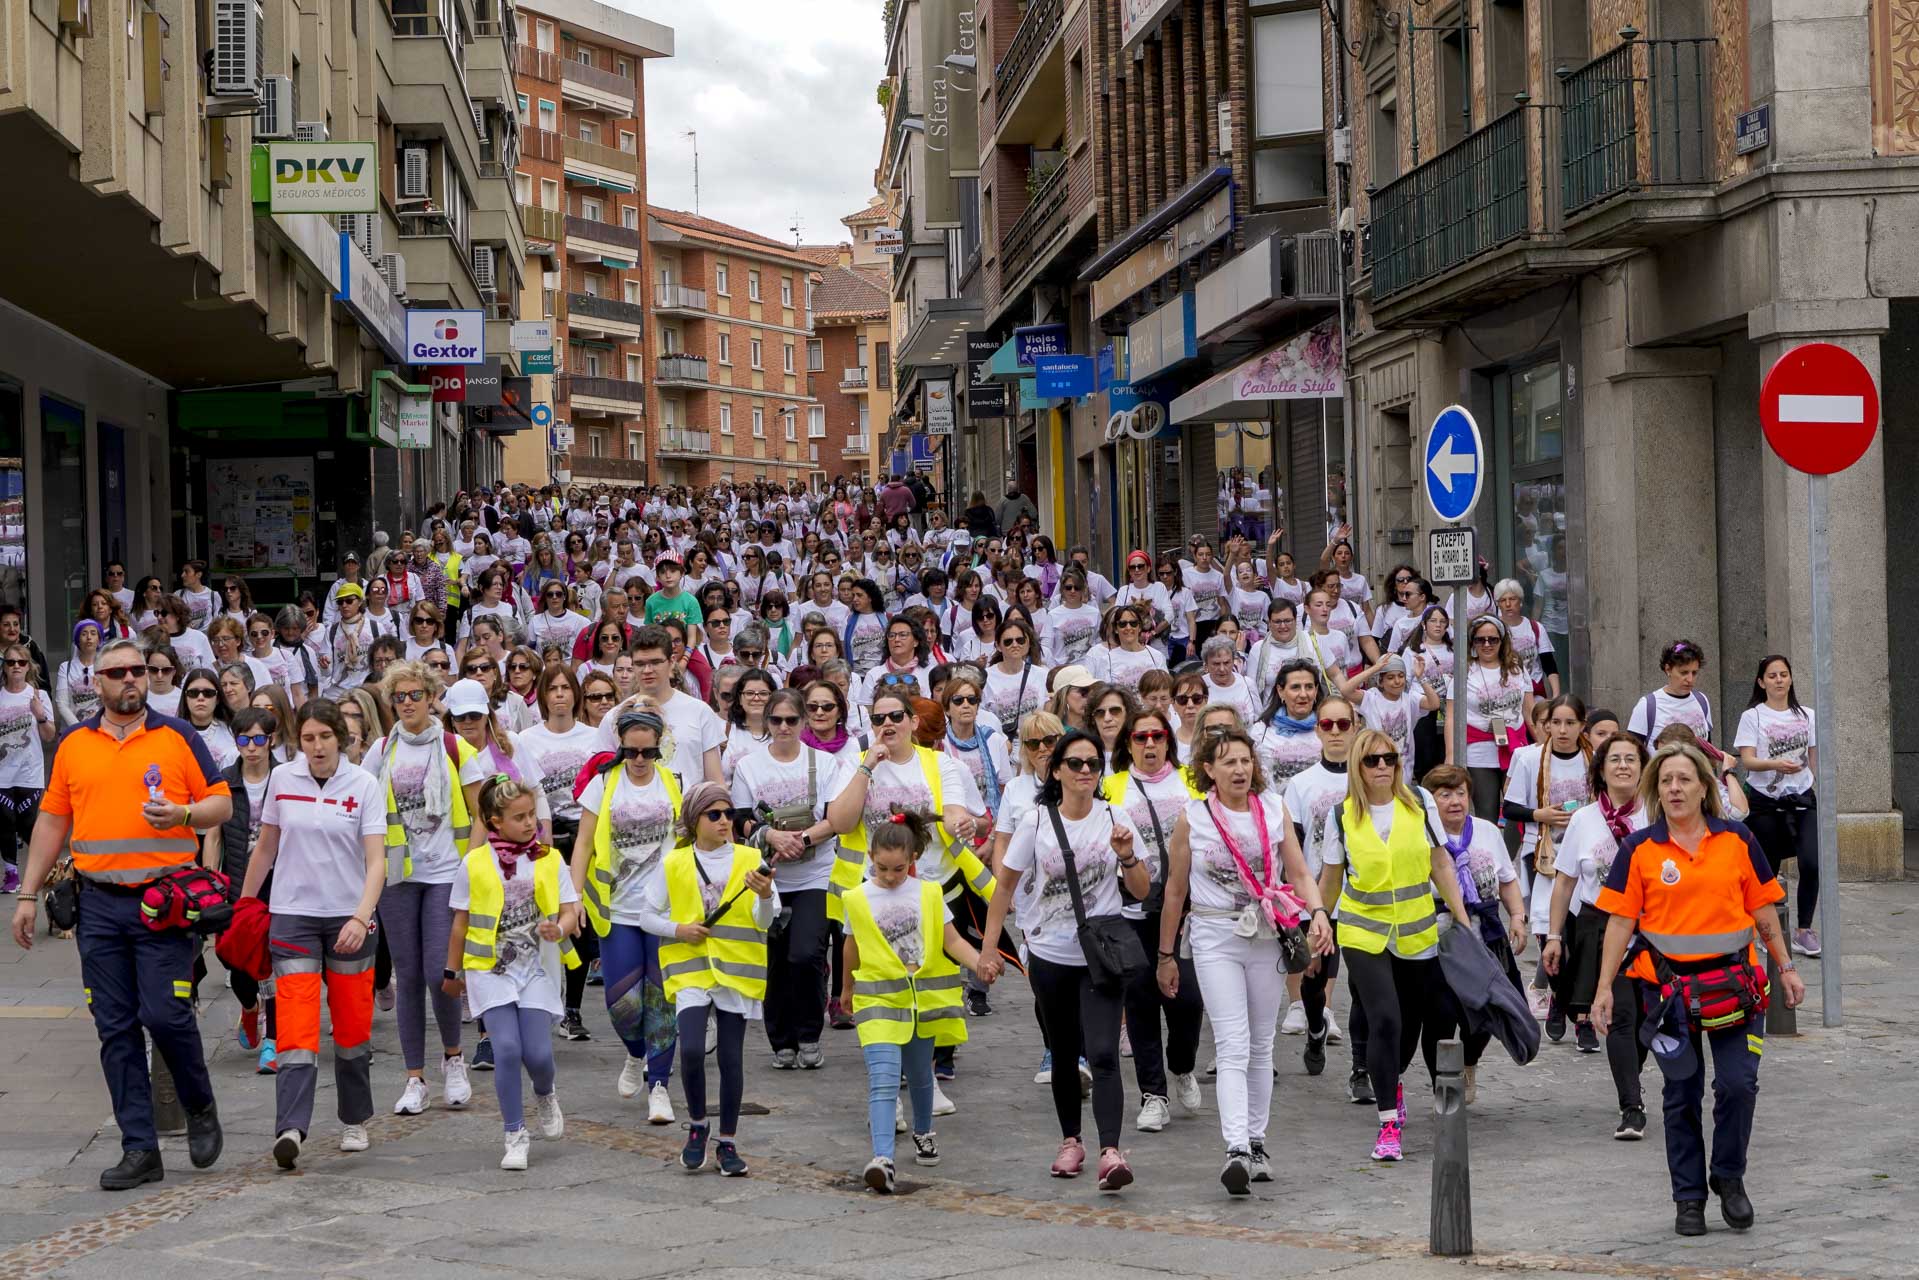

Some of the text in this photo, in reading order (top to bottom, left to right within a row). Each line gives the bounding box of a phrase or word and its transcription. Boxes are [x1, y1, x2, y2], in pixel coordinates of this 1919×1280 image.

[276, 158, 365, 184] DKV
[277, 187, 366, 199] SEGUROS MÉDICOS
[1025, 334, 1056, 345] Viajes
[413, 343, 477, 358] Gextor
[1025, 344, 1058, 353] Patiño
[532, 353, 552, 361] caser
[1241, 379, 1336, 398] Carlotta Style
[1436, 532, 1466, 548] EXCEPTO
[1434, 548, 1469, 565] EN HORARIO DE
[1435, 566, 1445, 579] CARGA
[1453, 564, 1470, 578] DESCARGA
